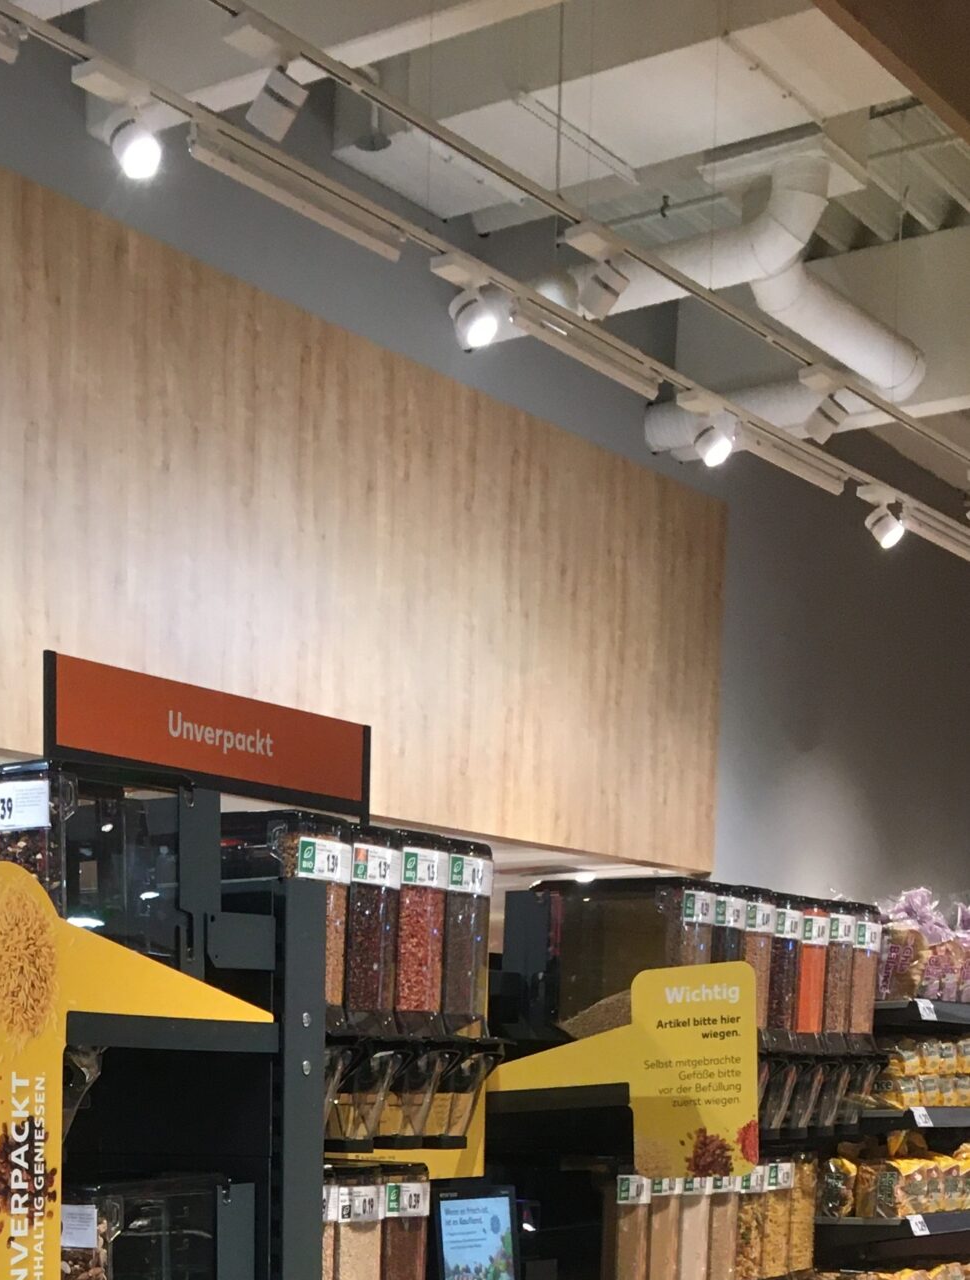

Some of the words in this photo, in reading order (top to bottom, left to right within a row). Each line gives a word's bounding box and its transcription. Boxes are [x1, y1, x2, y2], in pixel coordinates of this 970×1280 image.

[167, 710, 274, 757] Unverpackt
[302, 861, 313, 869] BIO
[664, 983, 740, 1005] Wichtig
[656, 1017, 691, 1030] Artikel
[693, 1016, 718, 1027] bitte
[720, 1014, 741, 1025] hier
[701, 1029, 741, 1041] wiegen.
[644, 1059, 672, 1070] Selbst
[675, 1055, 741, 1070] mitgebrachte
[678, 1070, 715, 1081] Gefäße
[717, 1069, 741, 1079] bitte
[658, 1086, 675, 1095] vor
[676, 1084, 692, 1094] der
[694, 1082, 741, 1095] Befüllung
[33, 1072, 46, 1191] GENIESSEN.
